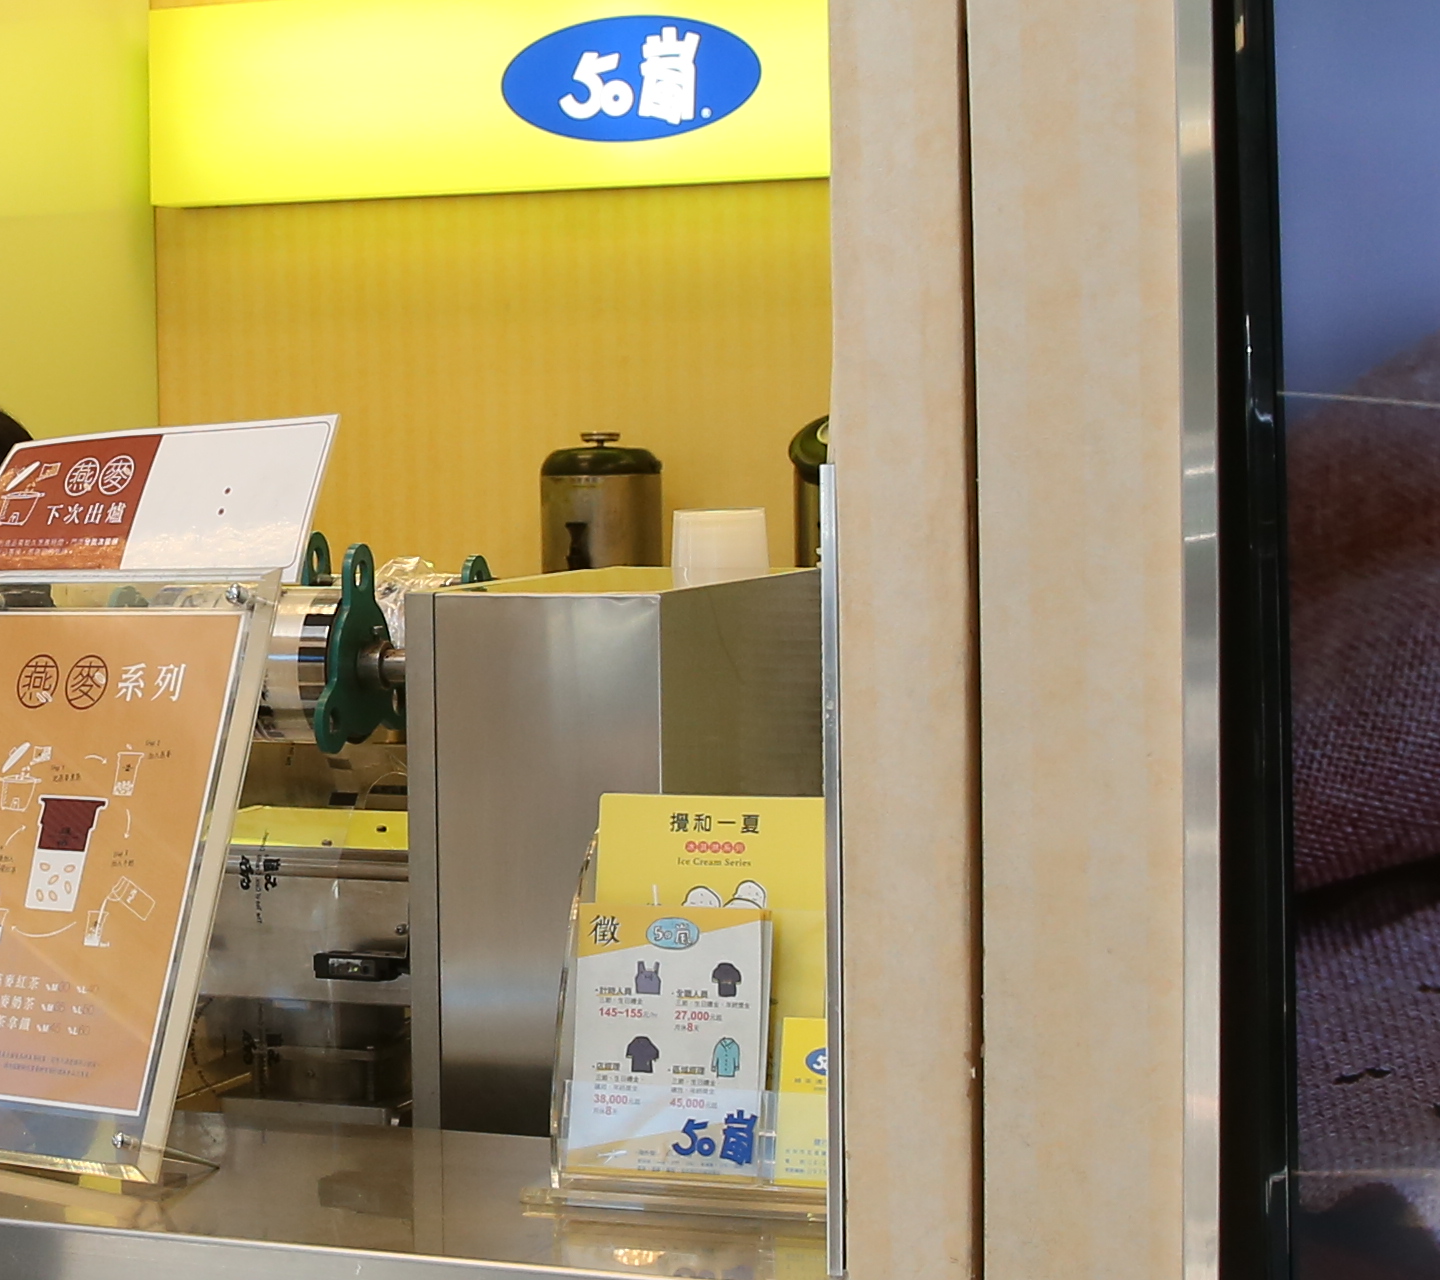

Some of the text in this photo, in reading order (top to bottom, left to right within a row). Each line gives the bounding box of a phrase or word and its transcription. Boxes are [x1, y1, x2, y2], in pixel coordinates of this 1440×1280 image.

[559, 26, 700, 125] 50嵐
[47, 502, 127, 525] 下次出爐
[678, 857, 690, 865] Ice
[693, 858, 721, 866] Cream
